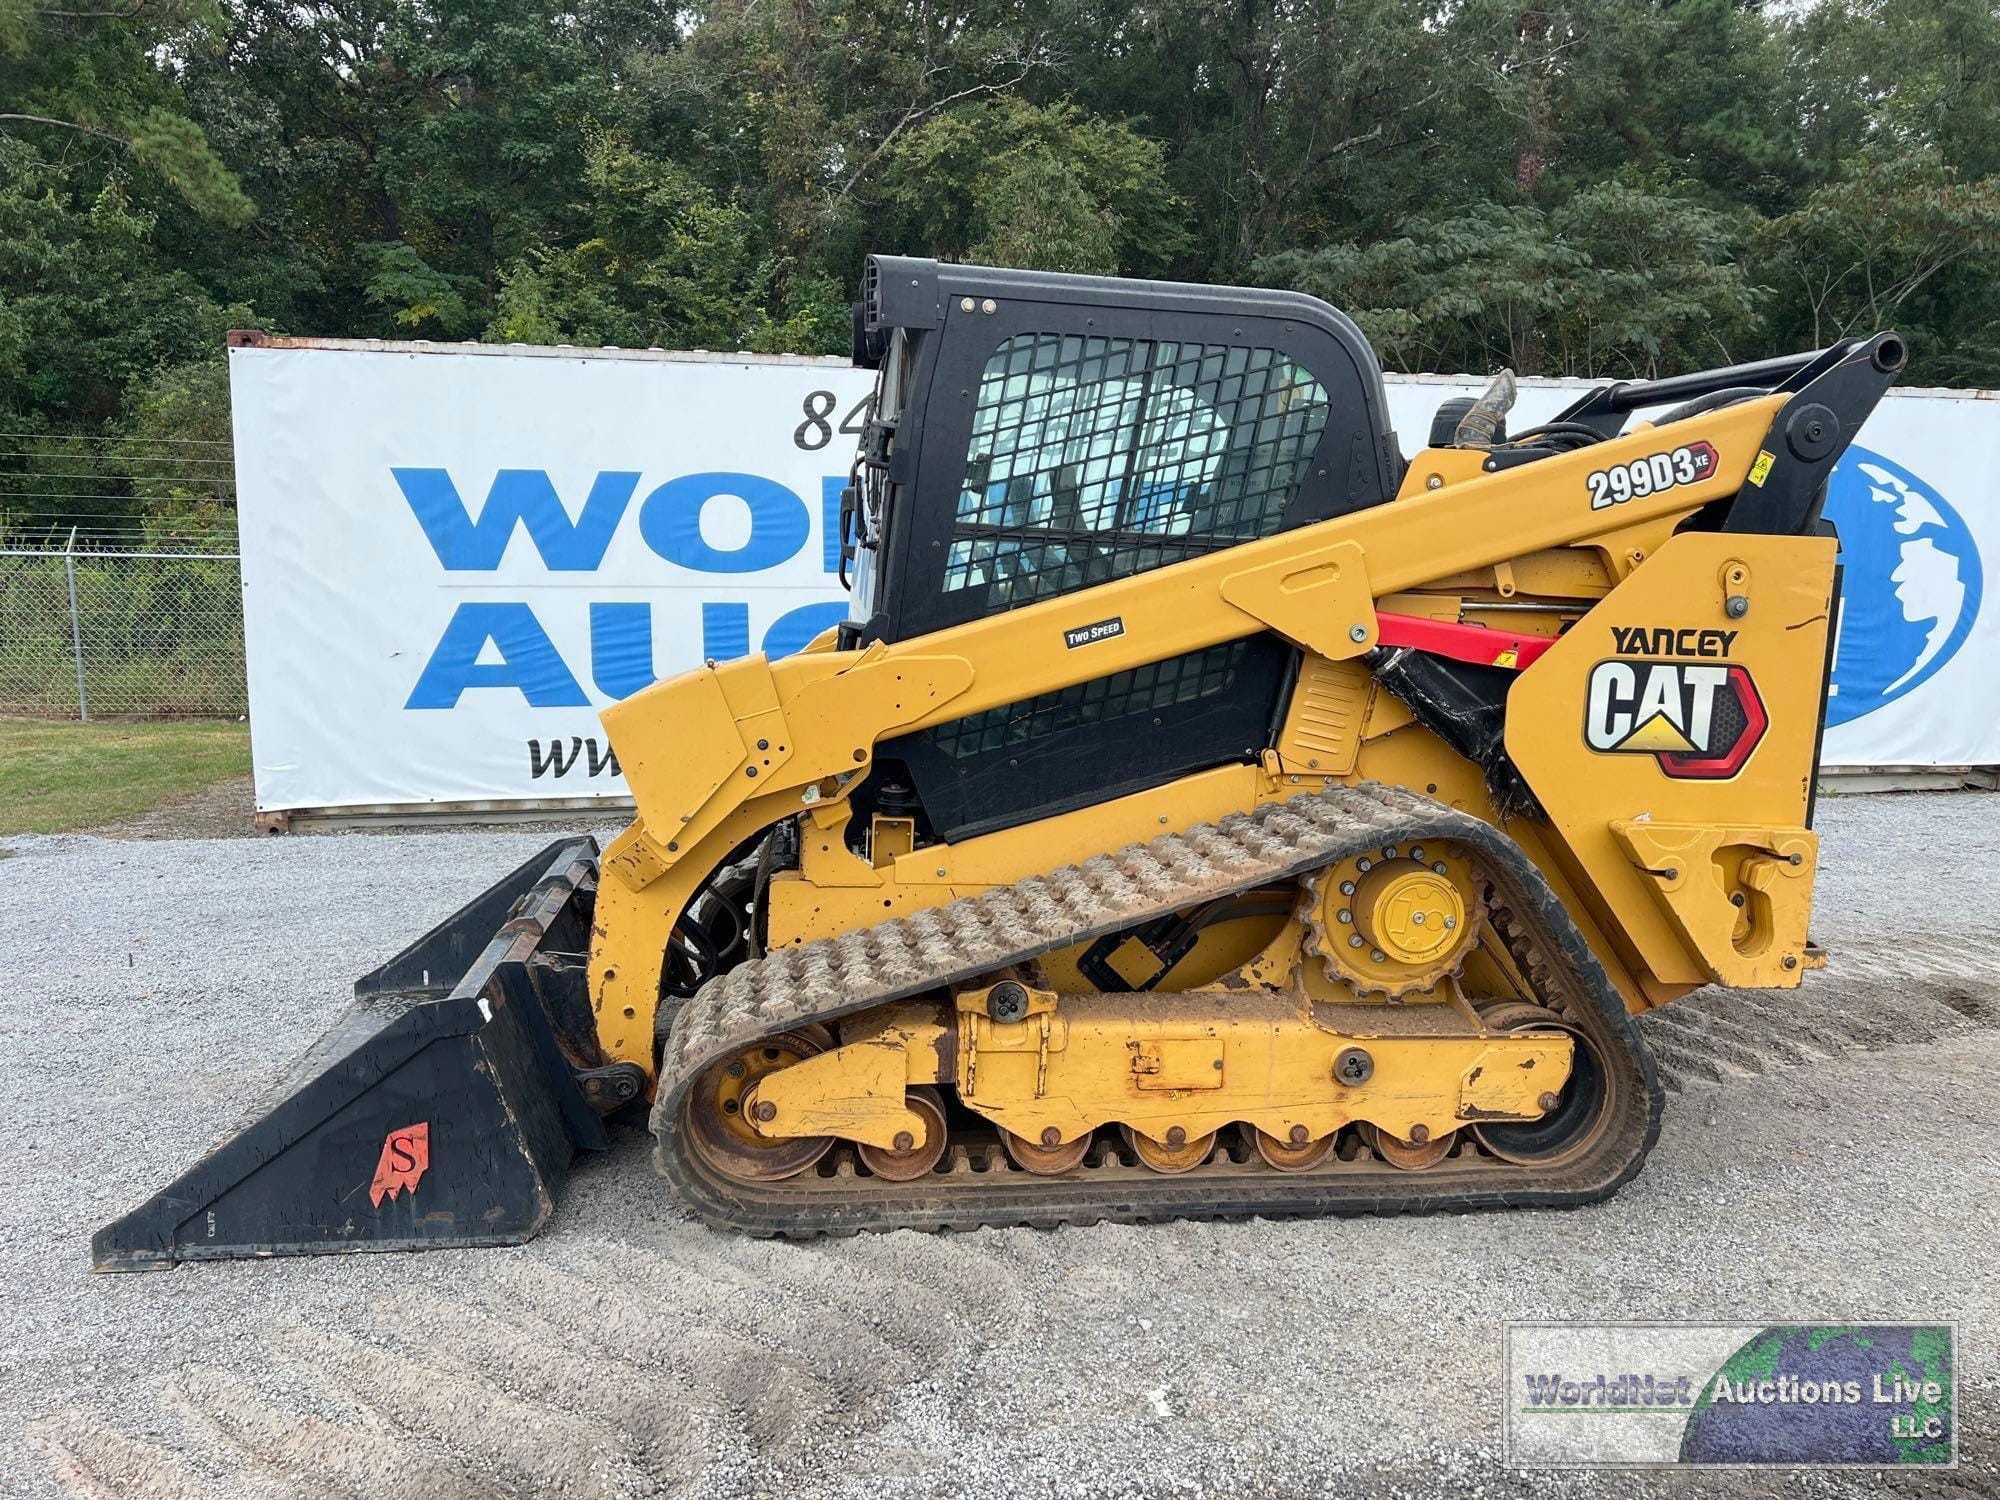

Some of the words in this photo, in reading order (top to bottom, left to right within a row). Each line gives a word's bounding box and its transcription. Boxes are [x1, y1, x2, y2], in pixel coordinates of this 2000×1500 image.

[1587, 447, 1696, 509] 299D3
[1694, 453, 1709, 469] XE
[1068, 631, 1090, 645] TWO
[1090, 622, 1120, 639] SPEED
[1610, 626, 1739, 657] YANCEY
[1587, 661, 1728, 752] CAT
[390, 1136, 417, 1174] S
